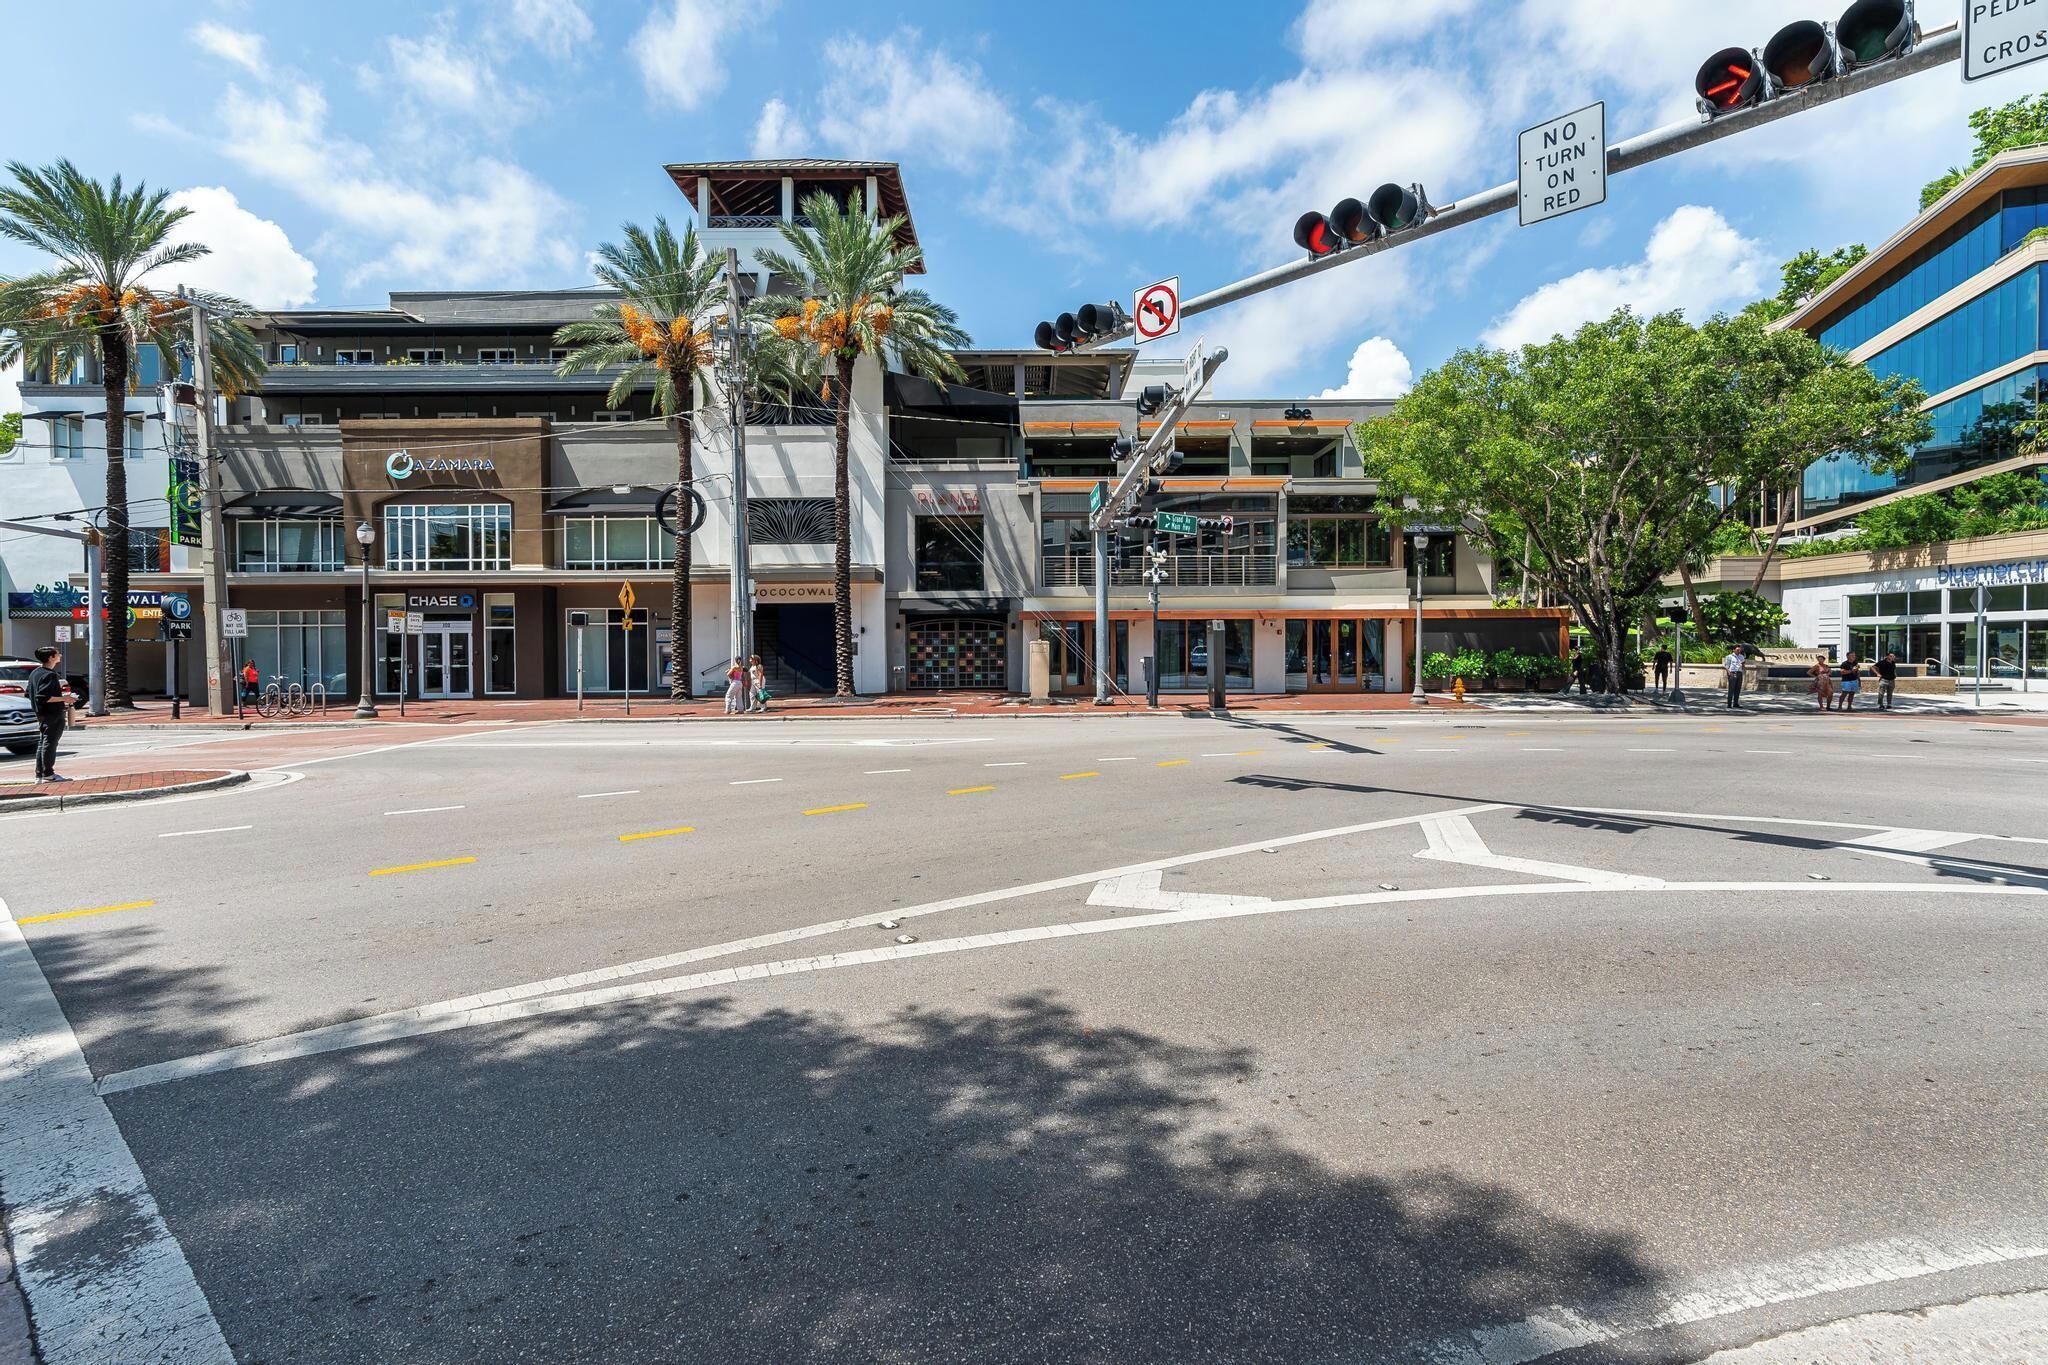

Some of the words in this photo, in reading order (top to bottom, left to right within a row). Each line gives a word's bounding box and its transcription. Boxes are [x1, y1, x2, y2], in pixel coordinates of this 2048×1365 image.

[1983, 30, 2048, 63] CROS
[1543, 121, 1577, 149] NO
[1535, 142, 1585, 171] TURN
[1547, 167, 1575, 188] ON
[1543, 188, 1580, 212] RED
[1284, 403, 1312, 419] sbe
[414, 459, 495, 471] AZAMARA
[179, 535, 202, 545] PARK
[176, 601, 188, 616] P
[409, 596, 458, 606] CHASE
[142, 609, 164, 617] ENTE
[170, 622, 191, 630] PARK
[393, 625, 401, 633] 15
